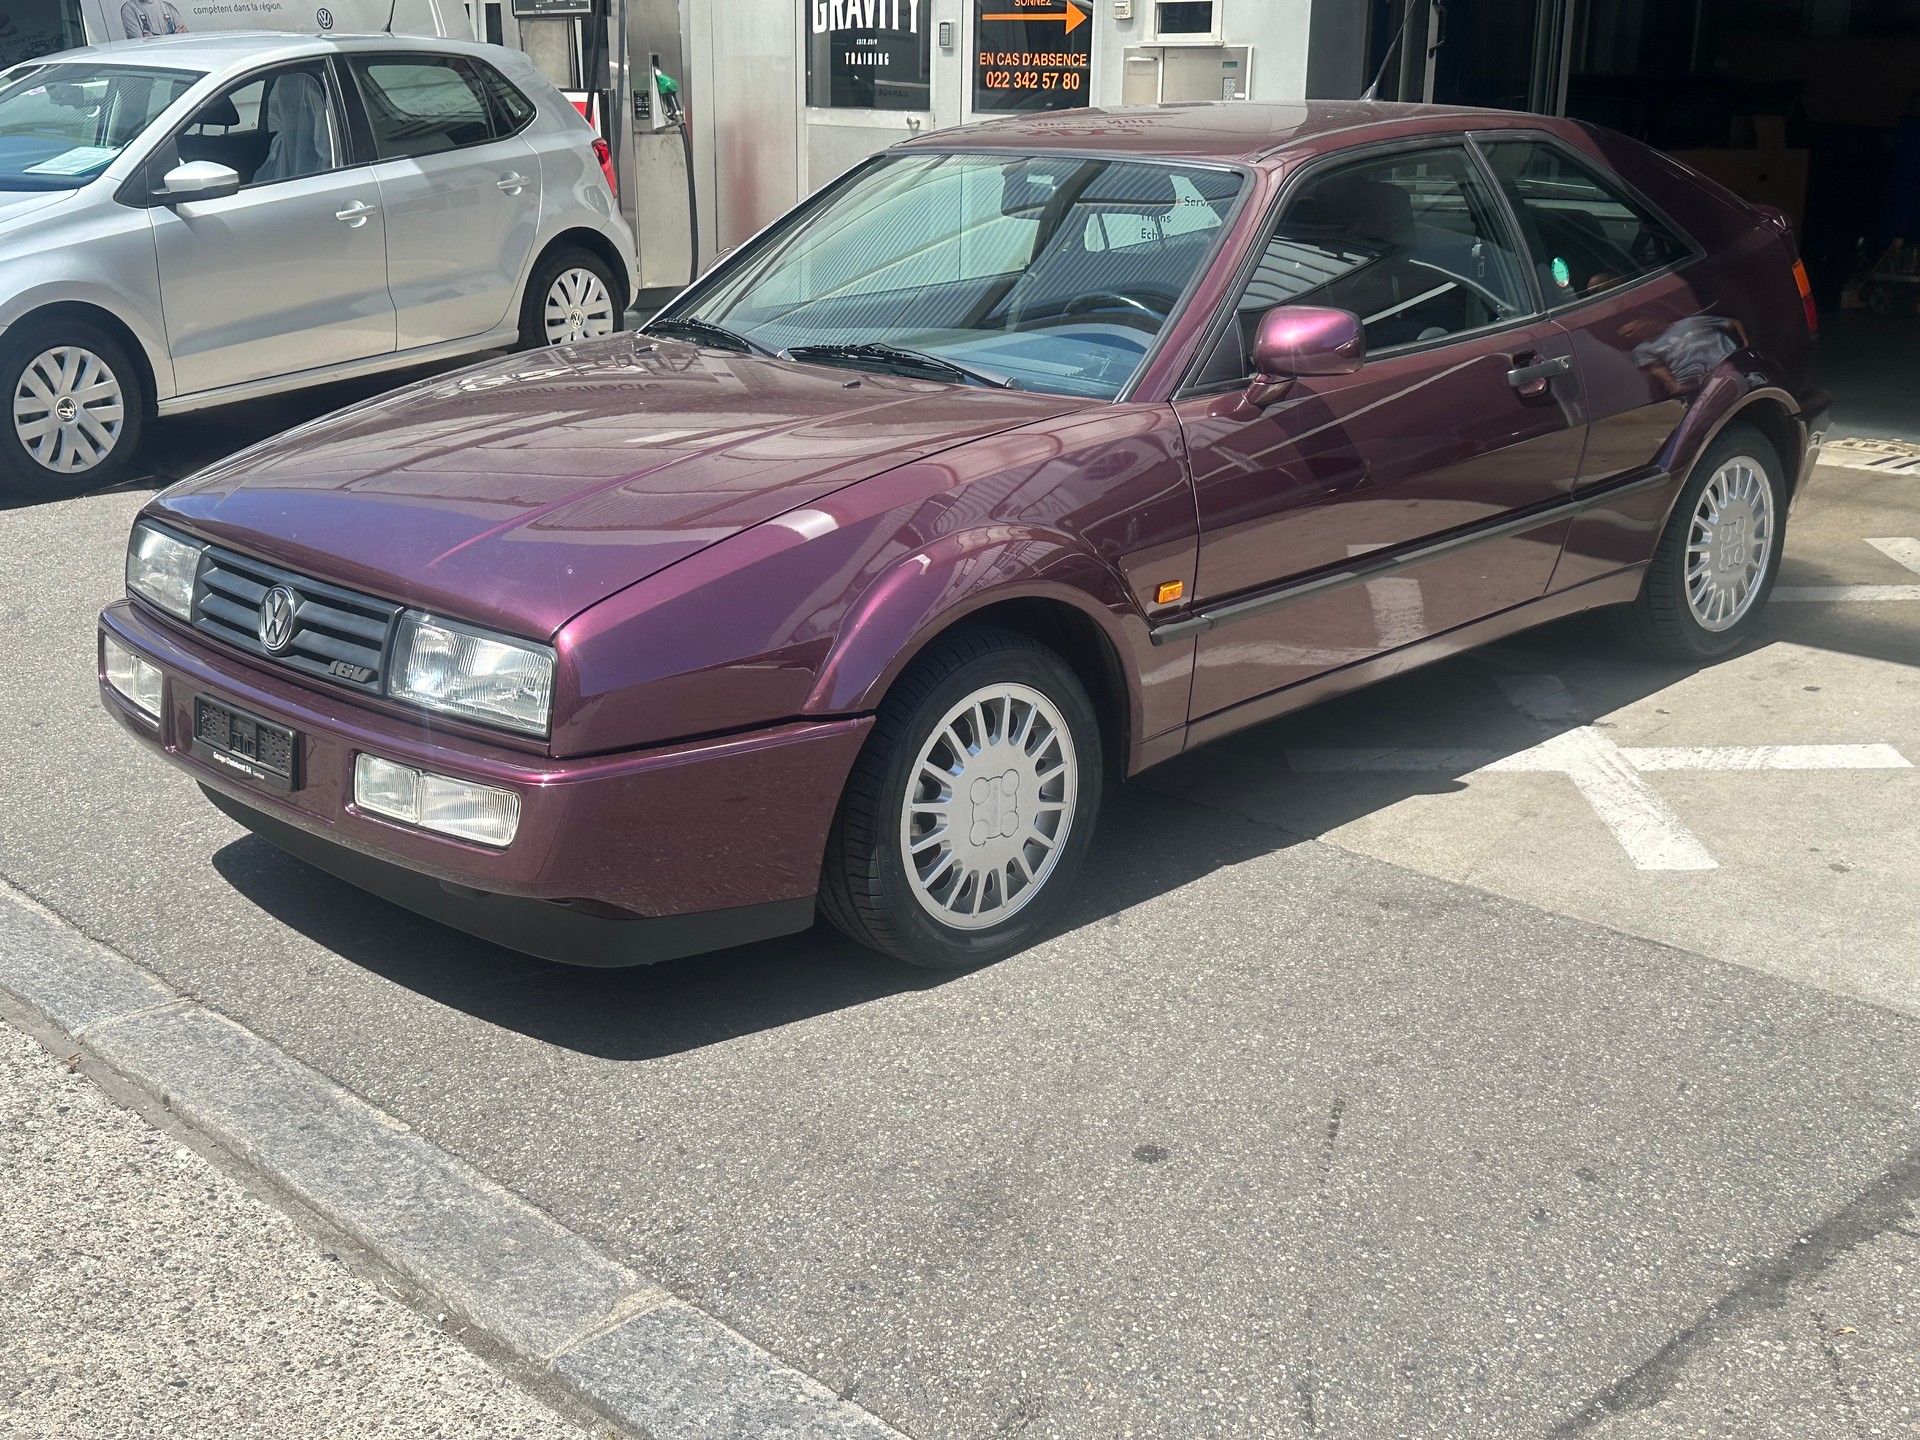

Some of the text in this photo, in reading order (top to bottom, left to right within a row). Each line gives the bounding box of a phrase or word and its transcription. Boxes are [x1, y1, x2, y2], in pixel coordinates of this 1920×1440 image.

[233, 3, 251, 12] dans
[251, 3, 259, 11] la
[812, 0, 919, 34] GRAVITY
[845, 52, 889, 66] TRAINING
[980, 53, 1087, 67] EN CAS D'ABSENCE
[986, 71, 1080, 90] 022 342 57 80
[328, 660, 373, 683] 16V
